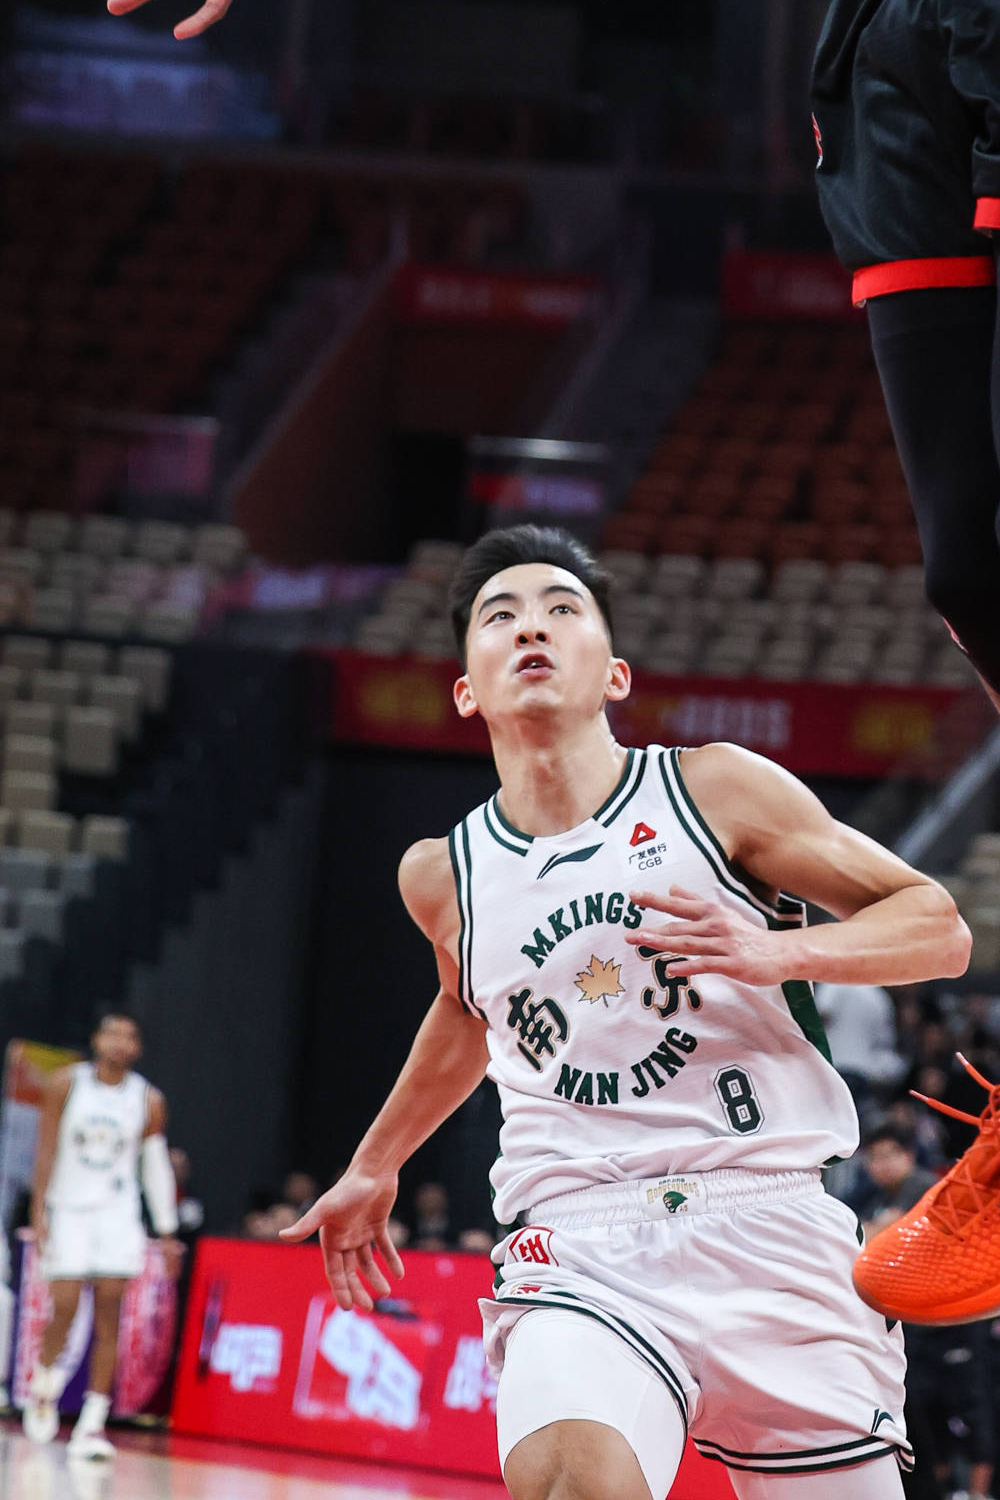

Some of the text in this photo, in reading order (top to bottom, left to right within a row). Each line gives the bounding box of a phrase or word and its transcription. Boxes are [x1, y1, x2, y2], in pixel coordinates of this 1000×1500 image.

[638, 855, 663, 871] CGB
[520, 891, 647, 969] MKINGS
[553, 1026, 699, 1106] NAN JING
[713, 1063, 765, 1137] 8
